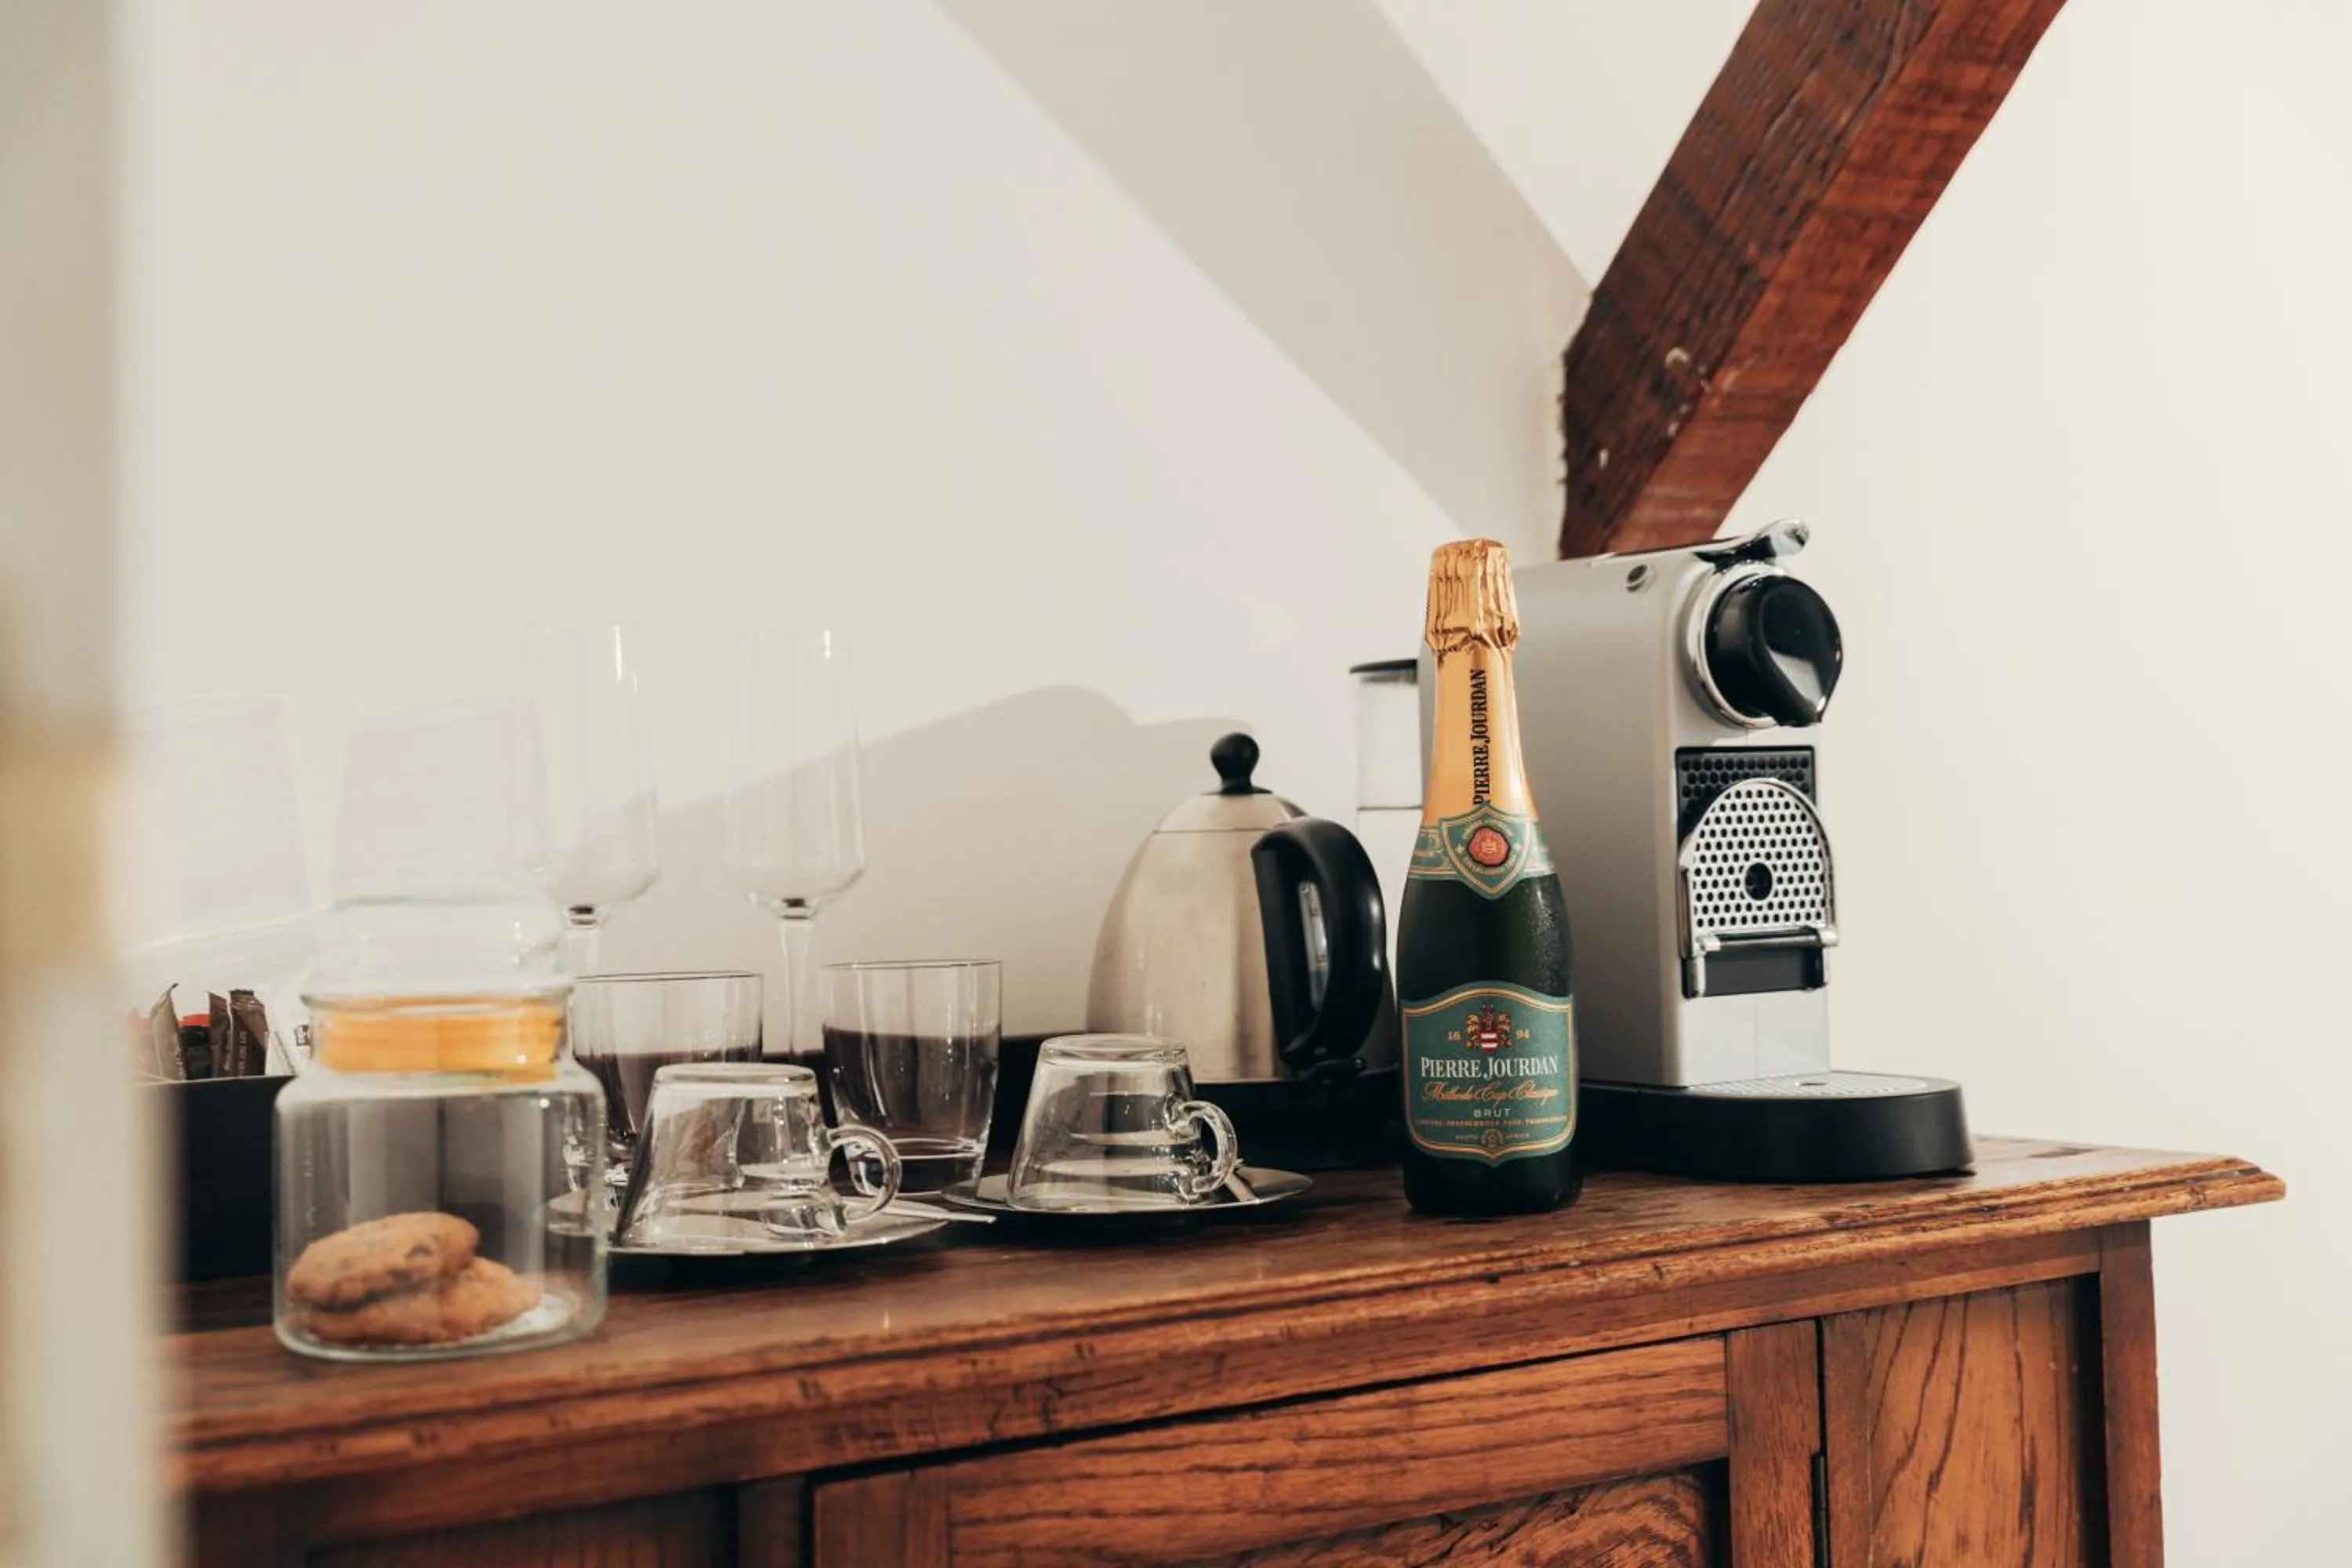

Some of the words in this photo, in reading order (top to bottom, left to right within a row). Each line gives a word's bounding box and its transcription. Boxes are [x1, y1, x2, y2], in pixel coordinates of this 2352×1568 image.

[1470, 669, 1490, 743] JOURDAN
[1473, 745, 1490, 806] PIERRE
[1448, 1030, 1461, 1041] 16
[1421, 1056, 1482, 1078] PIERRE
[1483, 1054, 1559, 1080] JOURDAN
[1473, 1108, 1512, 1117] BRUT
